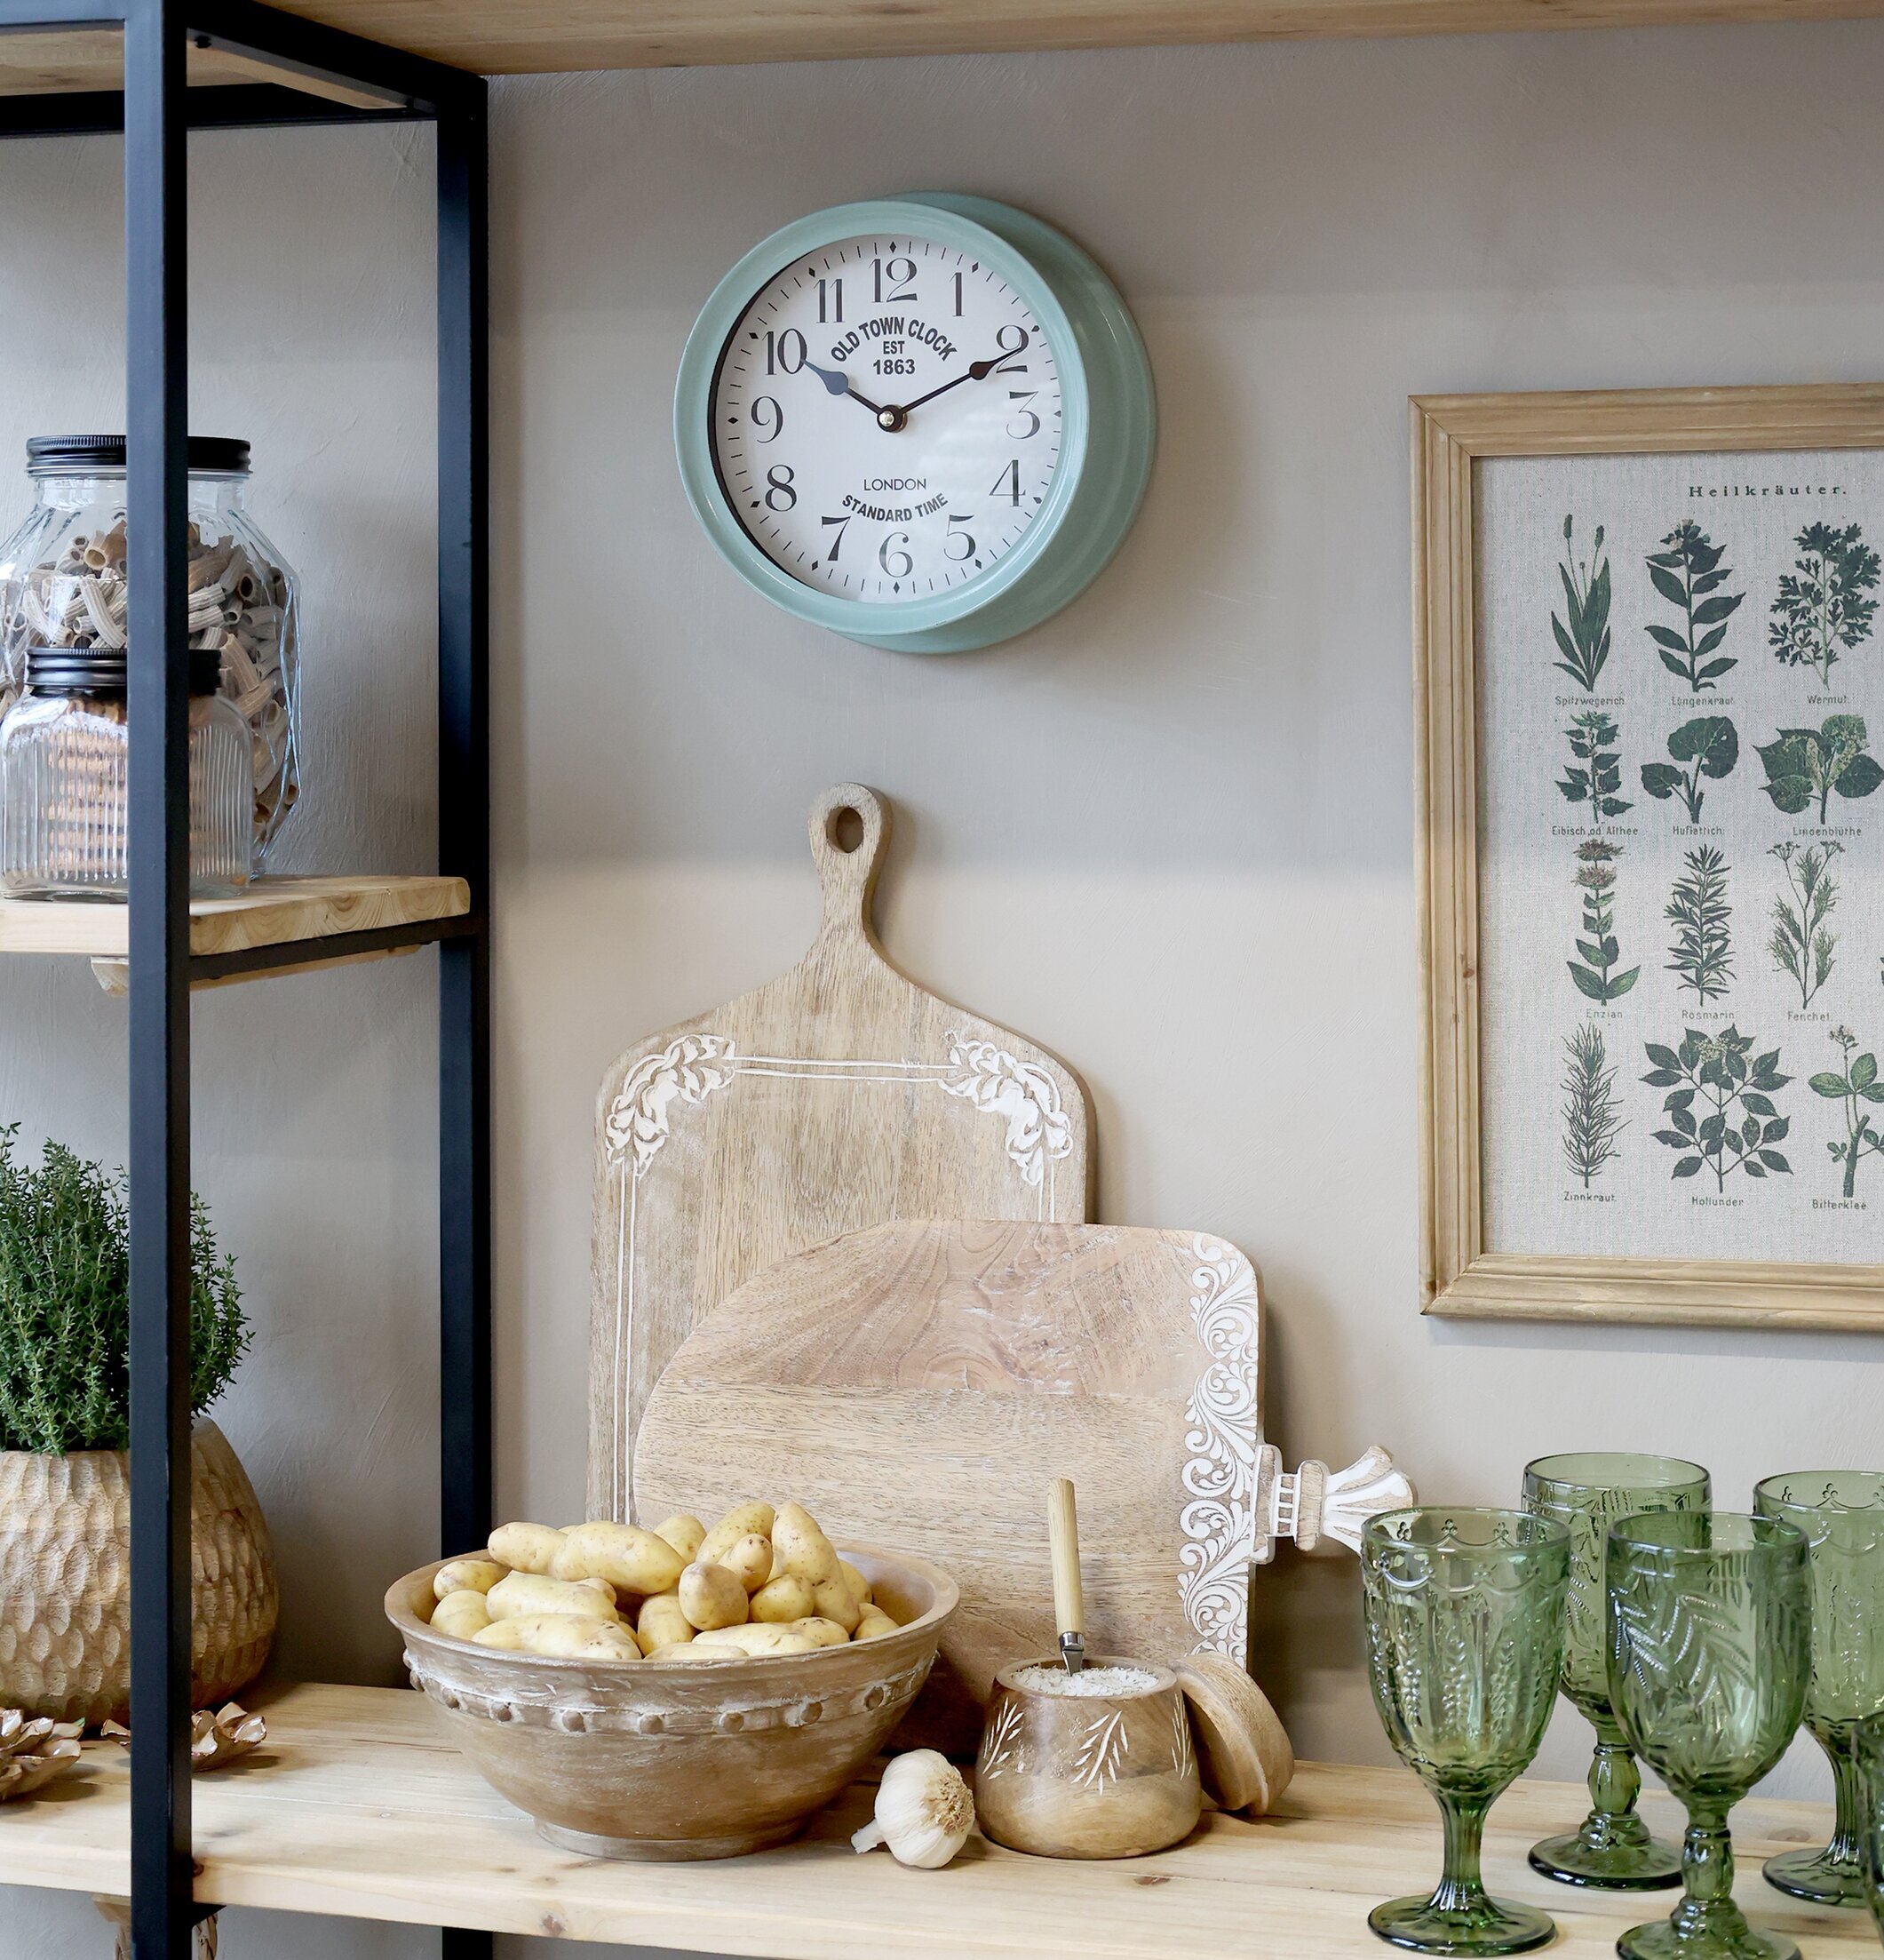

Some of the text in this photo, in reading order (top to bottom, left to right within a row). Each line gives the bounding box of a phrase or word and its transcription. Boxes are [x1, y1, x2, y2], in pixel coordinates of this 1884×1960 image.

[814, 278, 846, 323] 11
[868, 258, 918, 303] 12
[950, 272, 966, 317] 1
[761, 328, 807, 376] 10
[831, 316, 958, 362] OLD TOWN CLOCK
[883, 340, 905, 355] EST
[996, 324, 1029, 374] 2
[873, 359, 916, 375] 1863
[751, 396, 783, 443] 9
[1006, 391, 1041, 439] 3
[765, 465, 798, 512] 8
[863, 478, 926, 491] LONDON
[989, 459, 1026, 507] 4
[1689, 484, 1847, 498] Heilkräuter.
[842, 492, 948, 522] STANDARD TIME
[821, 515, 852, 562] 7
[878, 532, 914, 578] 6
[943, 514, 975, 561] 5
[1681, 1009, 1735, 1020] Rosmarin
[1692, 1196, 1744, 1207] Hollunder
[1812, 1199, 1867, 1210] Bitterklee
